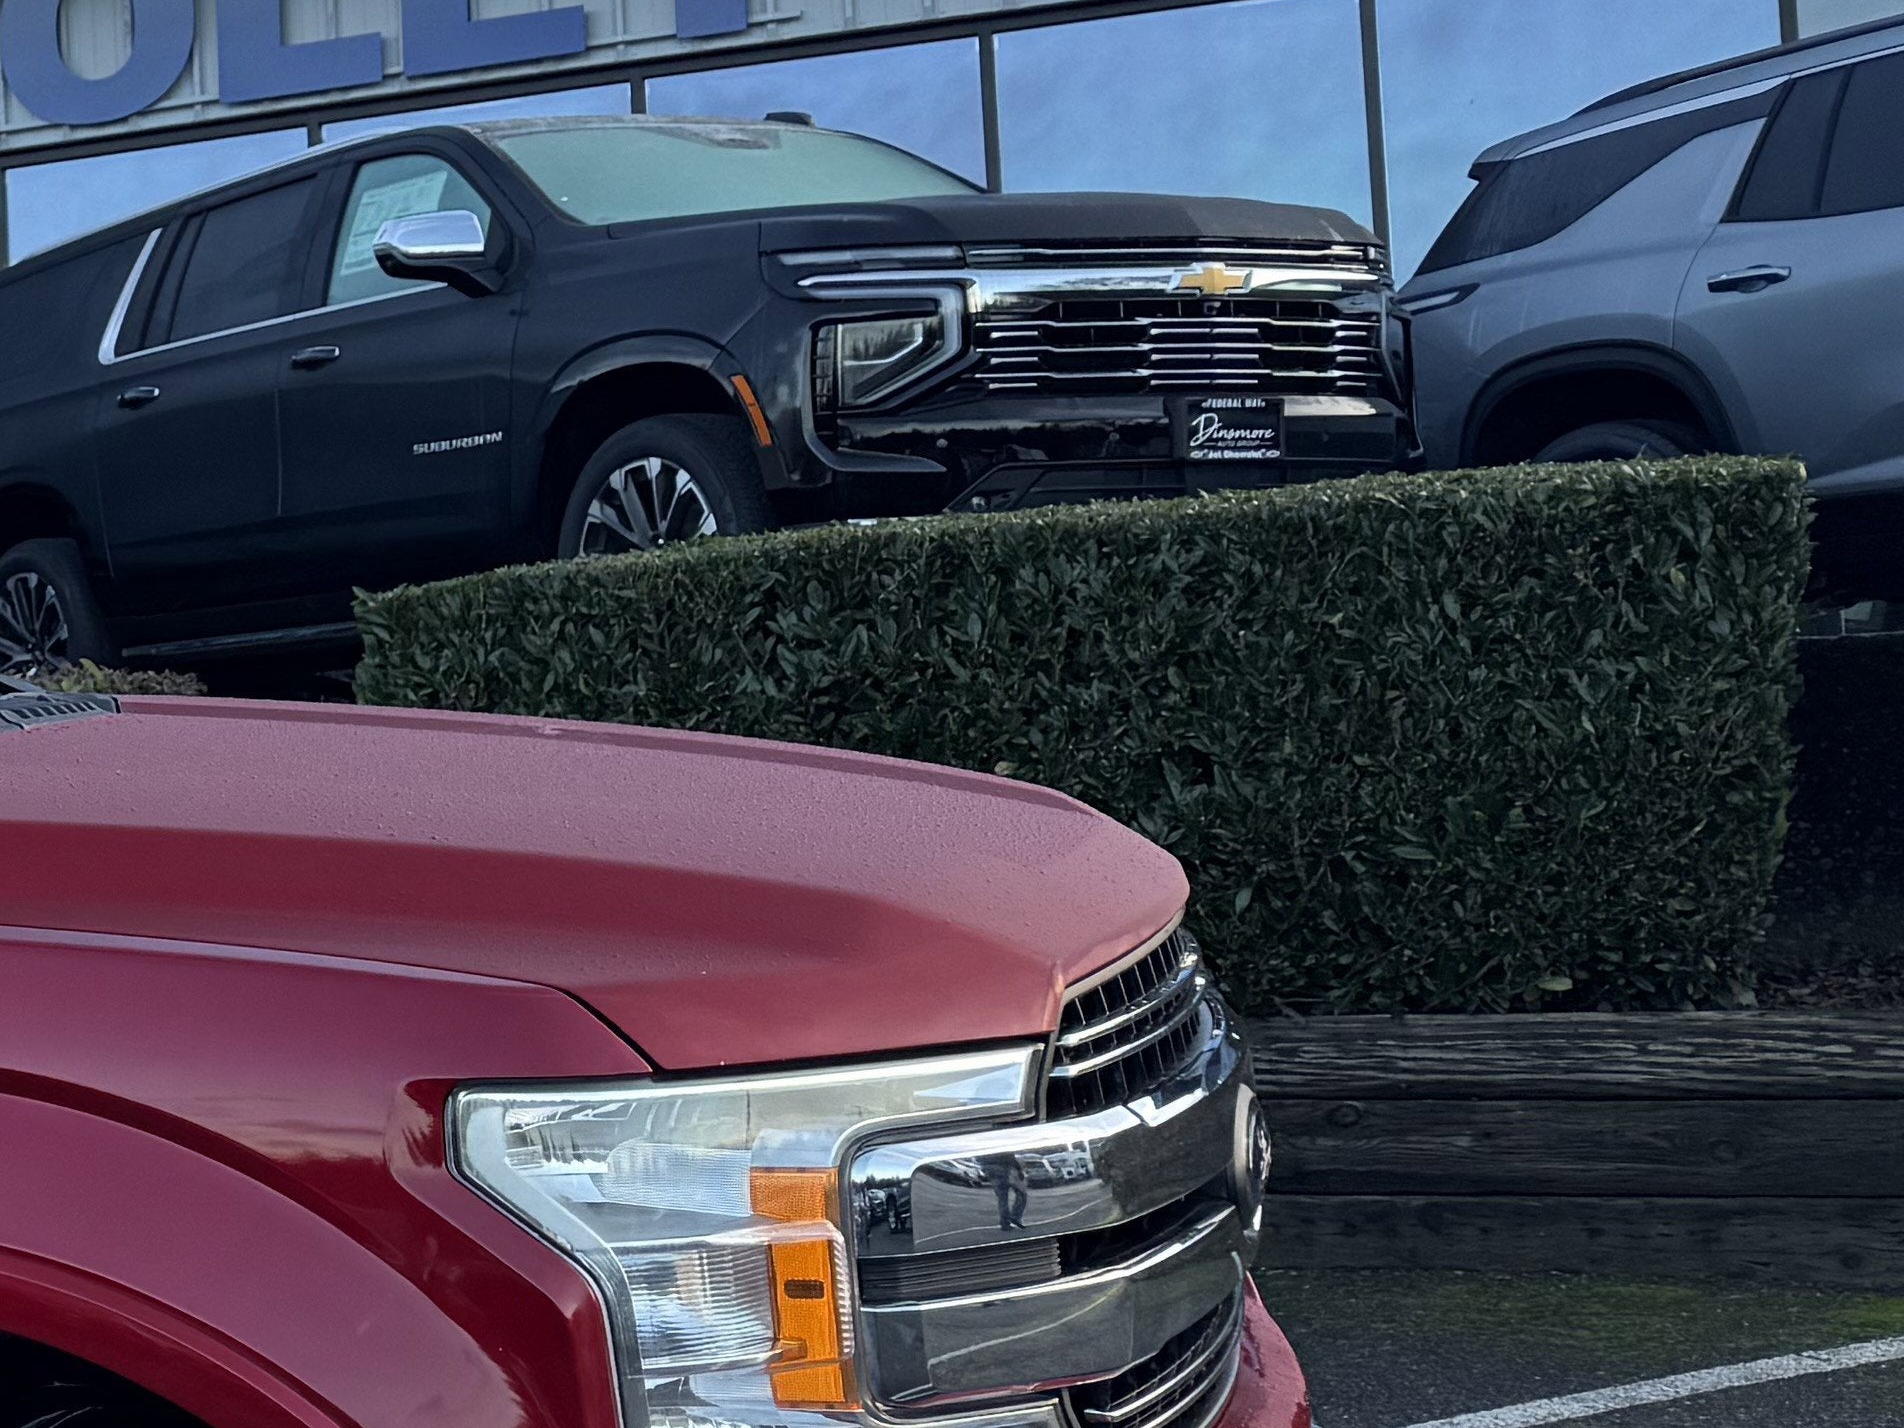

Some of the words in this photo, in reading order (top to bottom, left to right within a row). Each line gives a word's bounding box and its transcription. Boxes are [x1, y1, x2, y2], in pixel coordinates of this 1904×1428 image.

[1206, 398, 1242, 409] FEDERAL
[1190, 413, 1275, 446] Dinsmore
[412, 431, 503, 455] SUBURBAN
